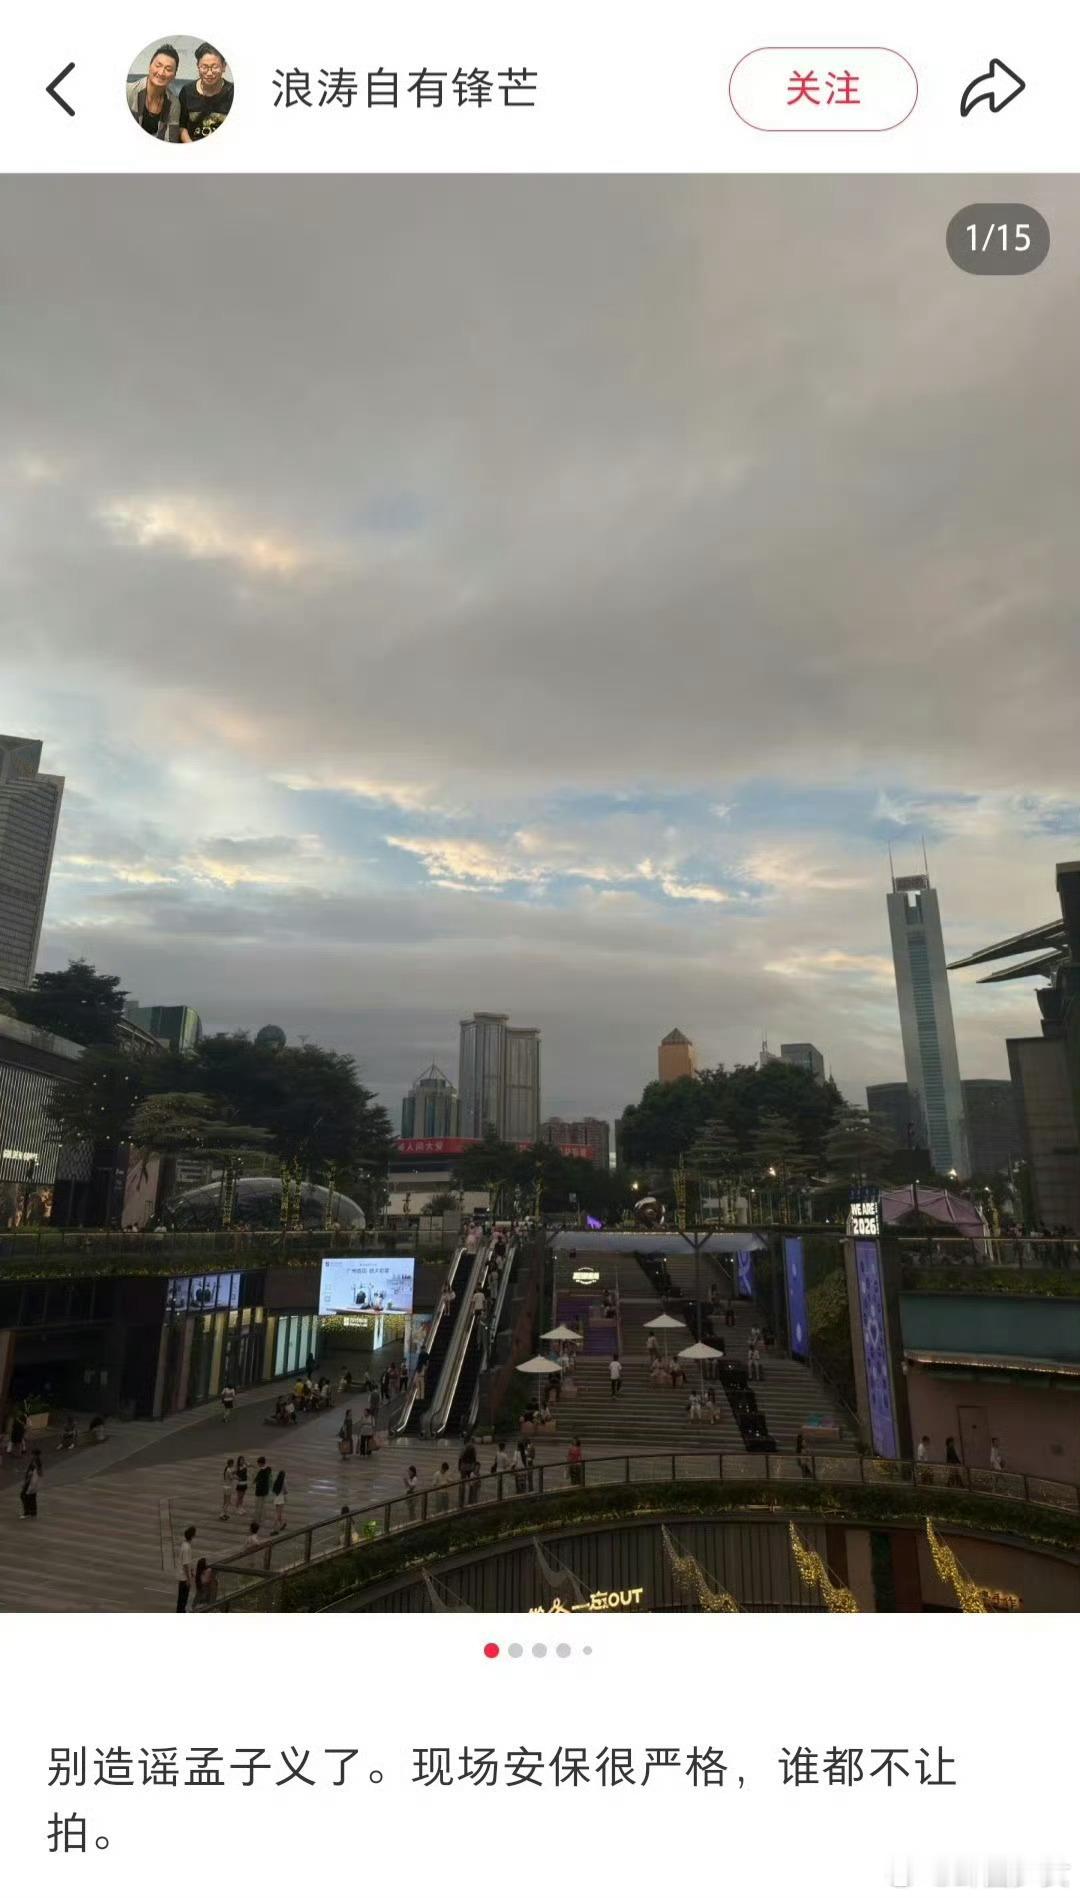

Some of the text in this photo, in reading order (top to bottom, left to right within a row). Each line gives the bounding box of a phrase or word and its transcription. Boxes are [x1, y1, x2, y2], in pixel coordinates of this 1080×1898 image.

[850, 1202, 875, 1215] WE ARE
[853, 1218, 876, 1235] 2026
